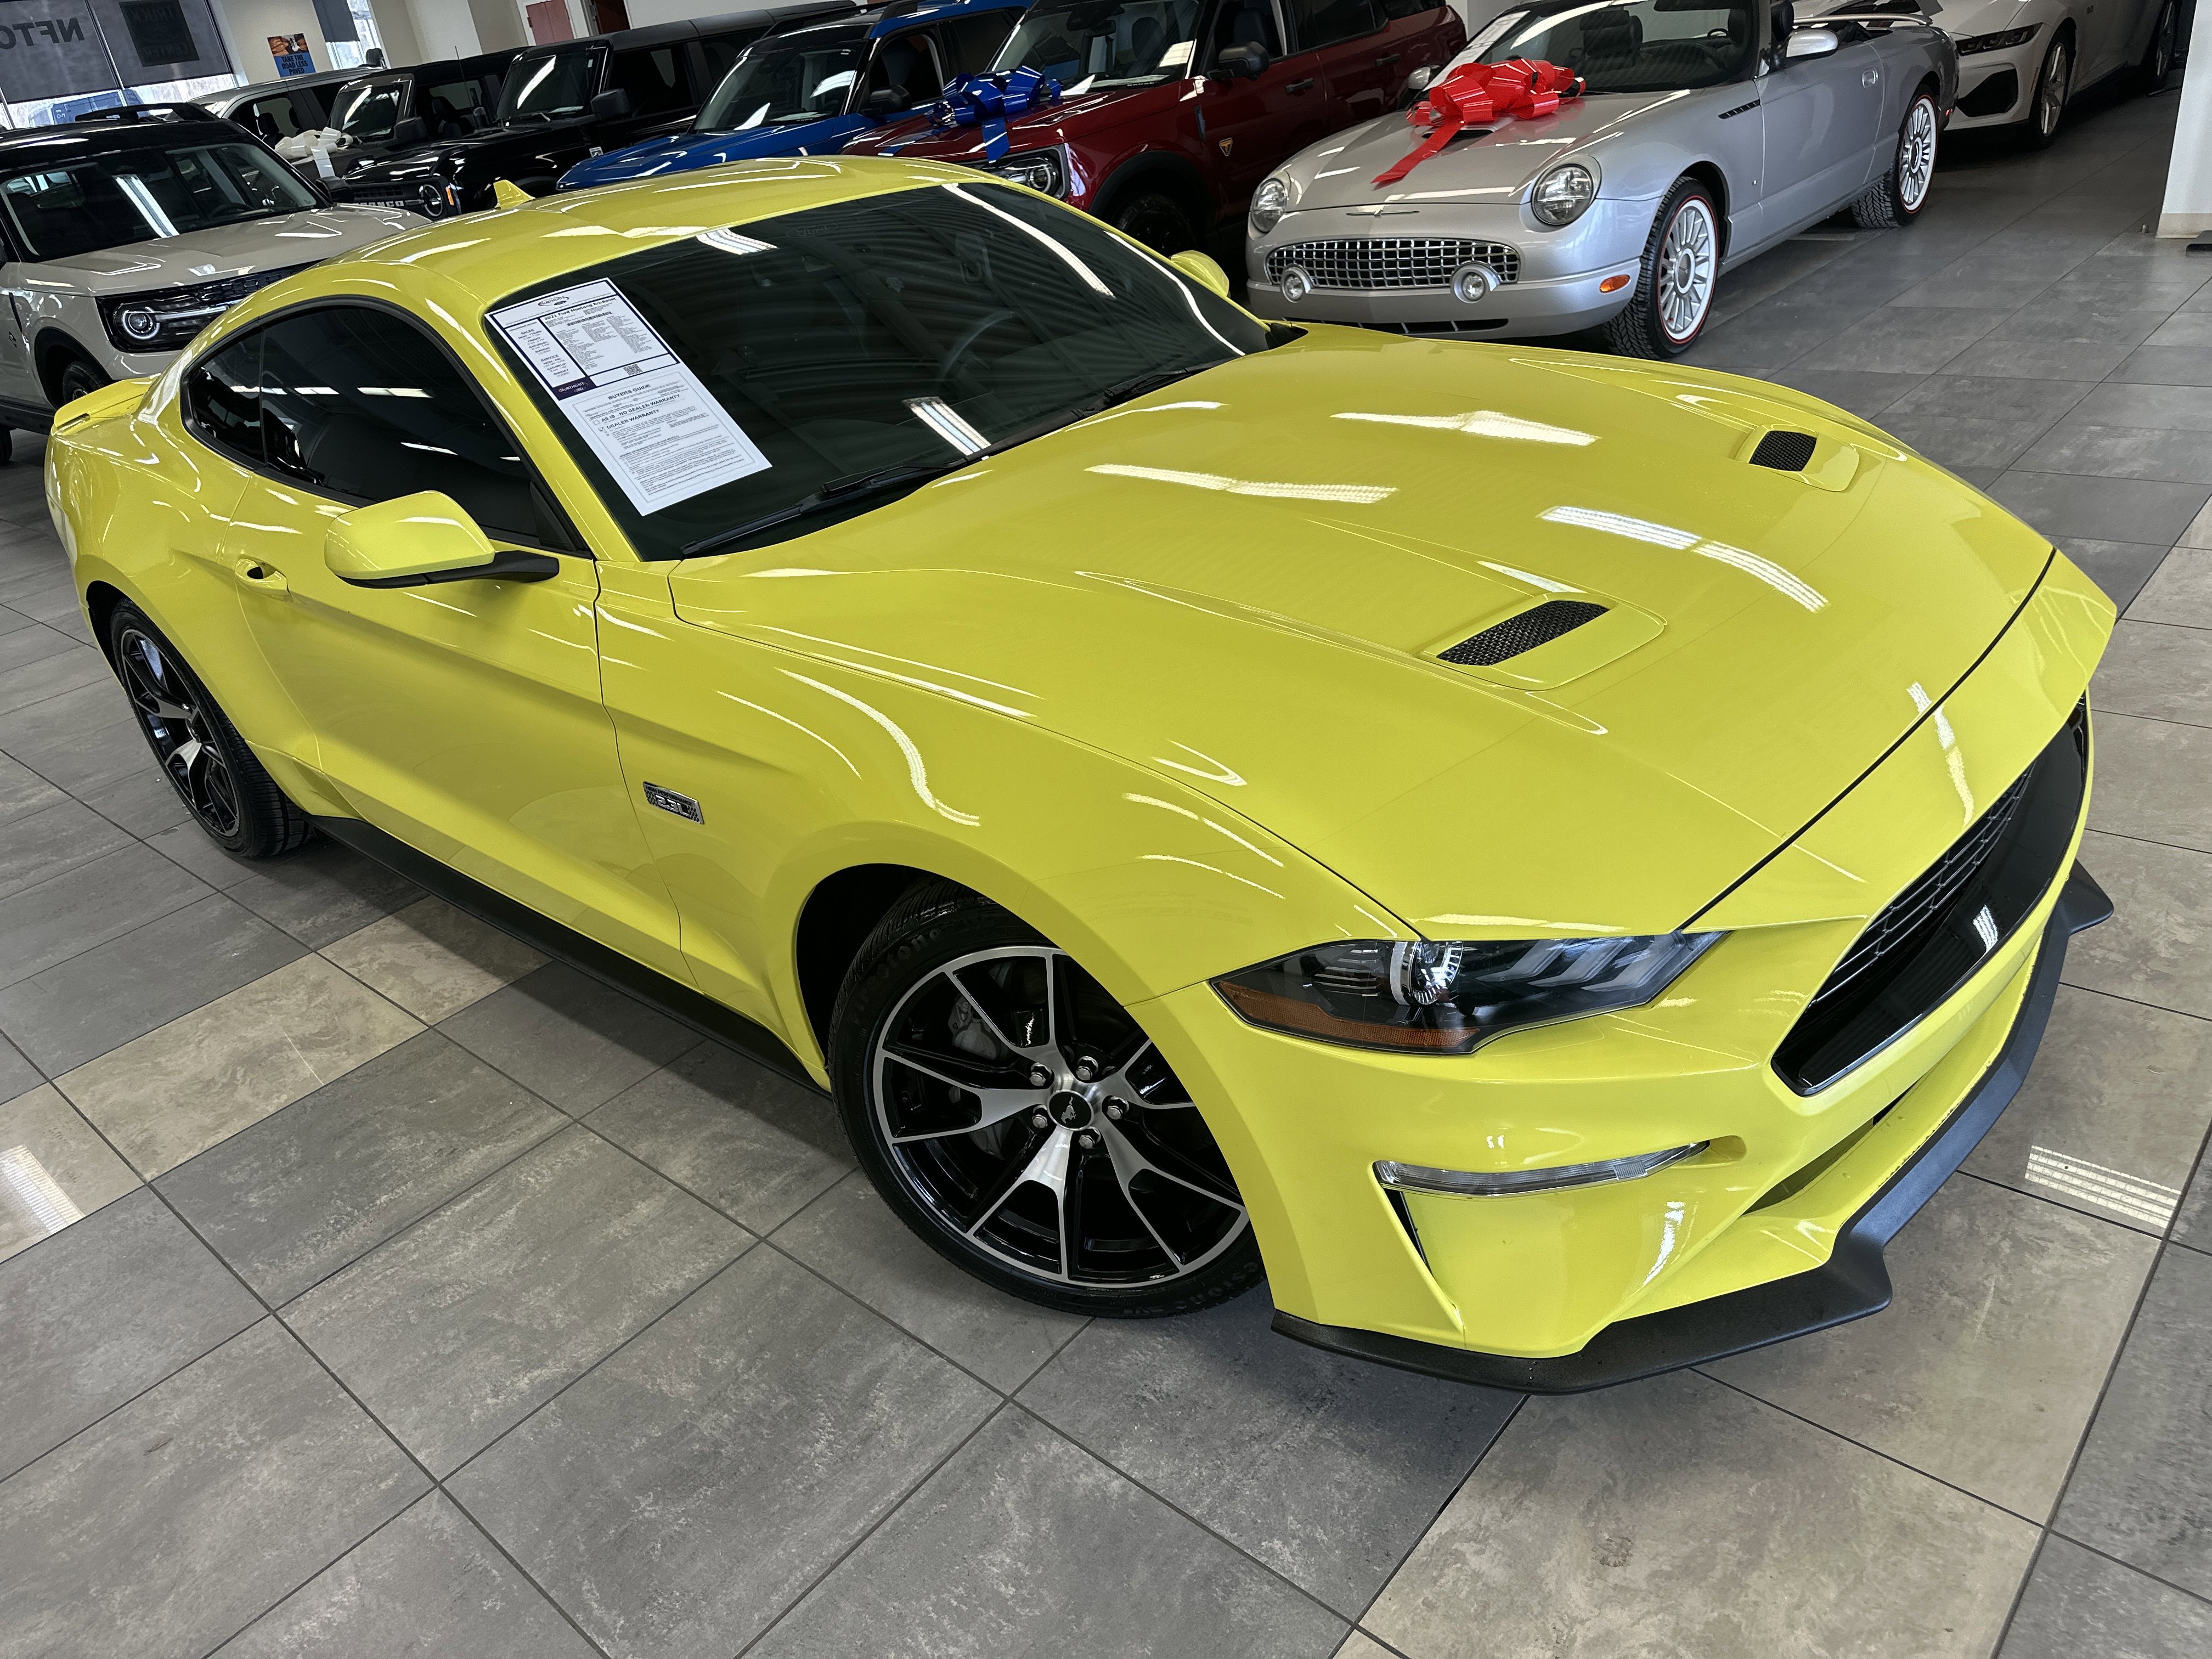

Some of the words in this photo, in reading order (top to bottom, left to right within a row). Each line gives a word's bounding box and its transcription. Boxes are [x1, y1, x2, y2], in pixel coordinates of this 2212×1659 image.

[571, 304, 592, 313] Mustang
[593, 297, 616, 306] EcoBoost
[558, 382, 585, 392] NORTHGATE
[608, 391, 633, 399] BUYERS
[628, 404, 650, 413] DEALER
[650, 394, 680, 405] WARRANTY
[607, 420, 629, 428] DEALER
[629, 410, 660, 421] WARRANTY
[655, 794, 690, 816] 2.3L
